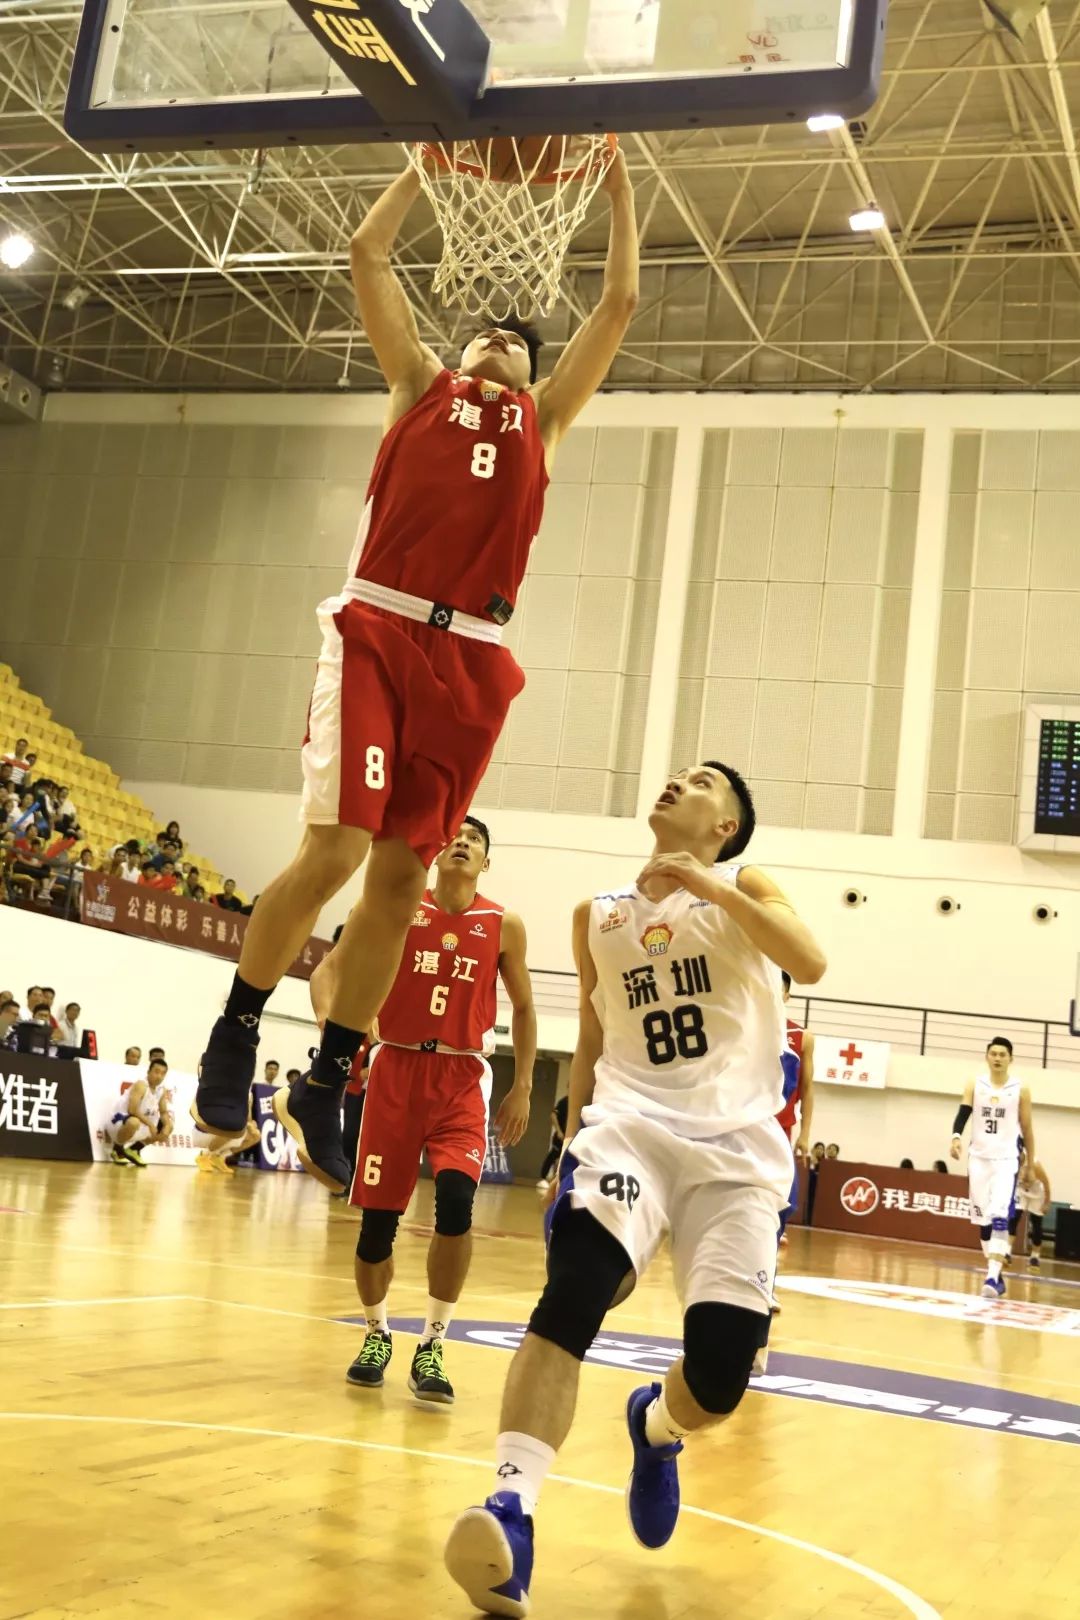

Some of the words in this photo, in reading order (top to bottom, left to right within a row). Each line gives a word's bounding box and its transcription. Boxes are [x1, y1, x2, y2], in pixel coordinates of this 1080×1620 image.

[471, 443, 497, 479] 8
[365, 745, 385, 790] 8
[127, 895, 189, 932] 公益体彩
[413, 950, 479, 983] 湛江
[622, 954, 712, 1010] 深圳
[430, 985, 450, 1016] 6
[643, 1004, 708, 1065] 88
[826, 1067, 869, 1082] 医疗点
[0, 1073, 58, 1135] 准者
[985, 1119, 998, 1134] 31
[363, 1154, 383, 1186] 6
